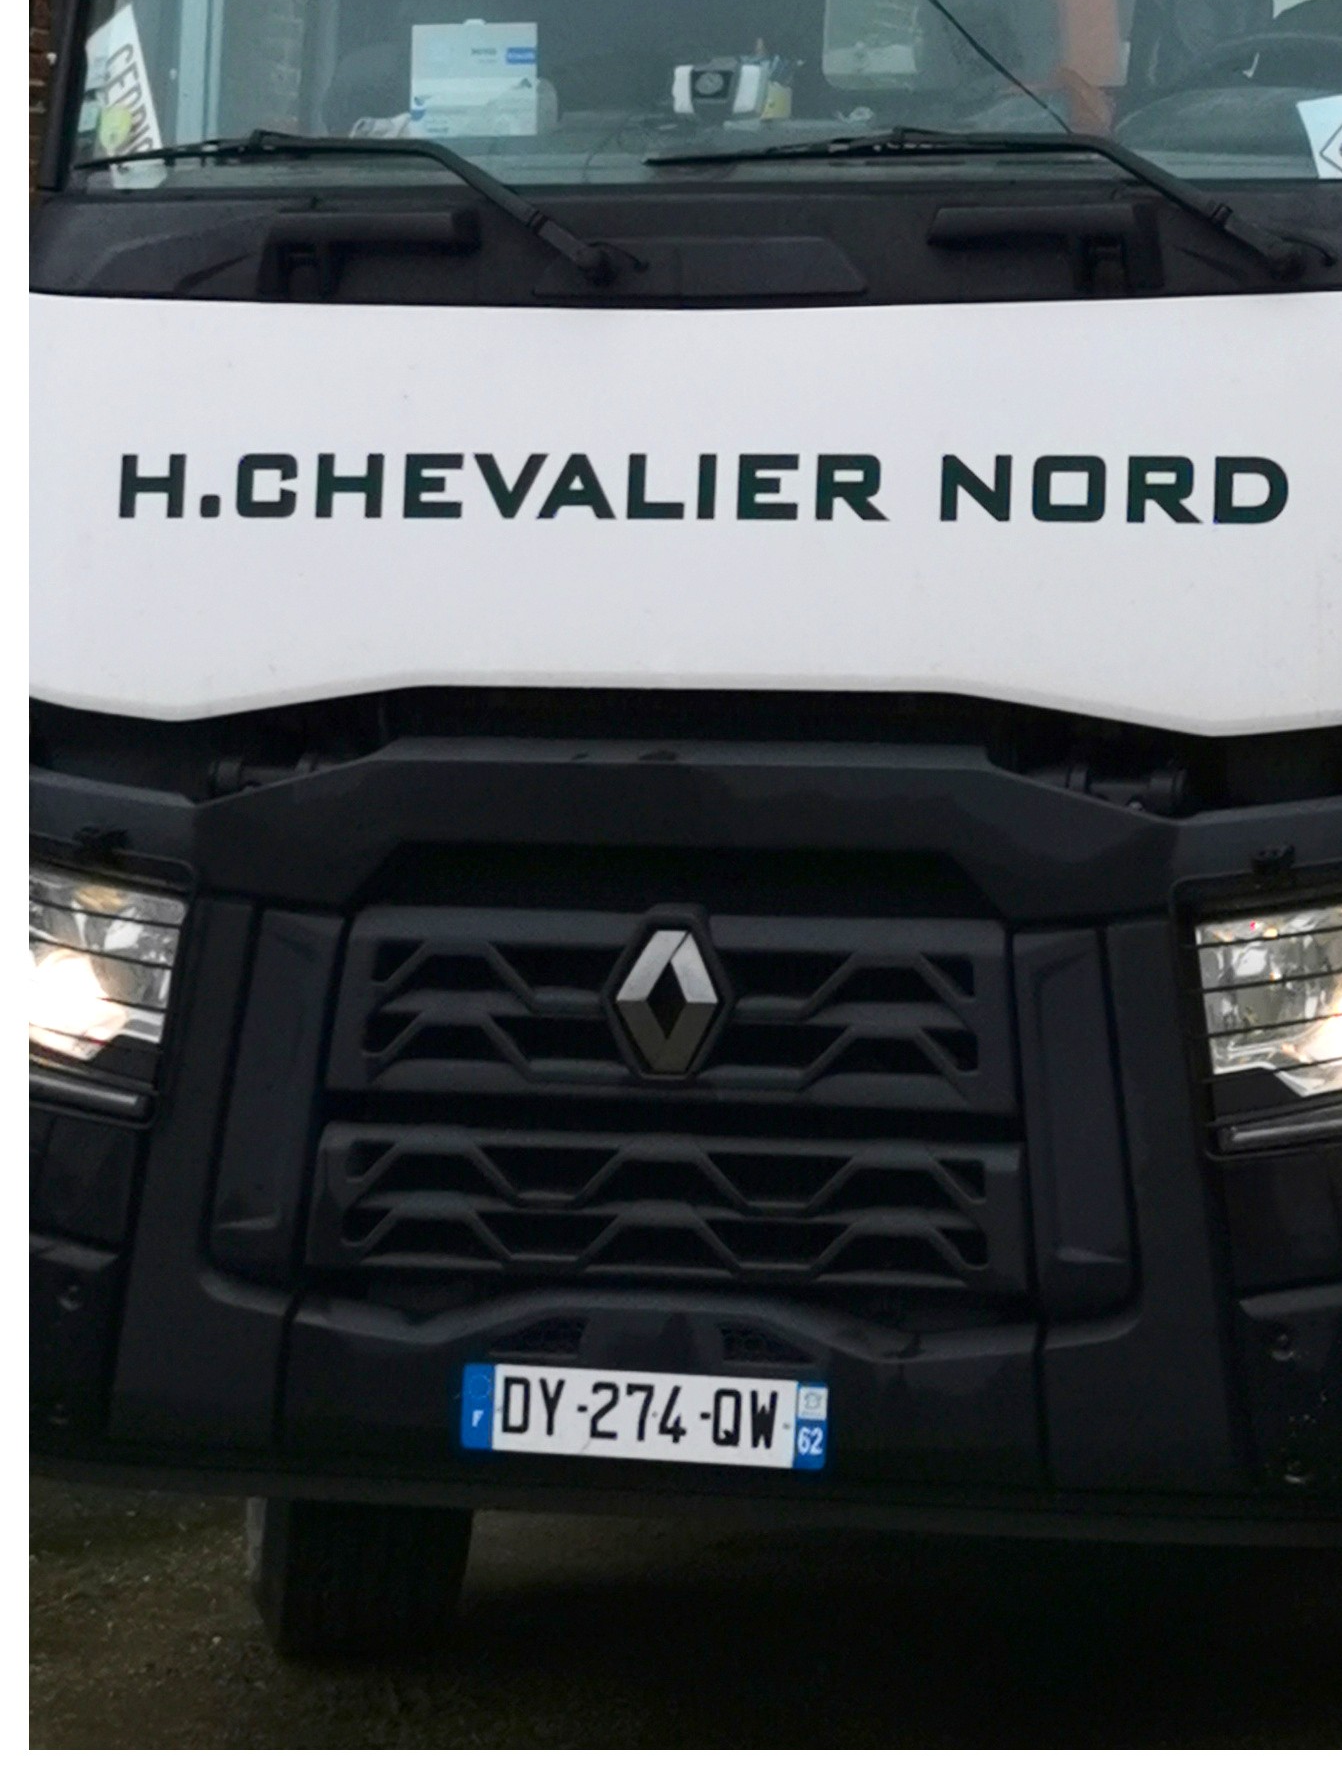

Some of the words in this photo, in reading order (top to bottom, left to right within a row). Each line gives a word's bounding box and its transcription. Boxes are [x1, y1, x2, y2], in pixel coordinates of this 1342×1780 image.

[117, 452, 890, 522] H.CHEVALIER
[939, 455, 1290, 525] NORD
[502, 1377, 778, 1449] DY-274-QW
[798, 1426, 823, 1456] 62
